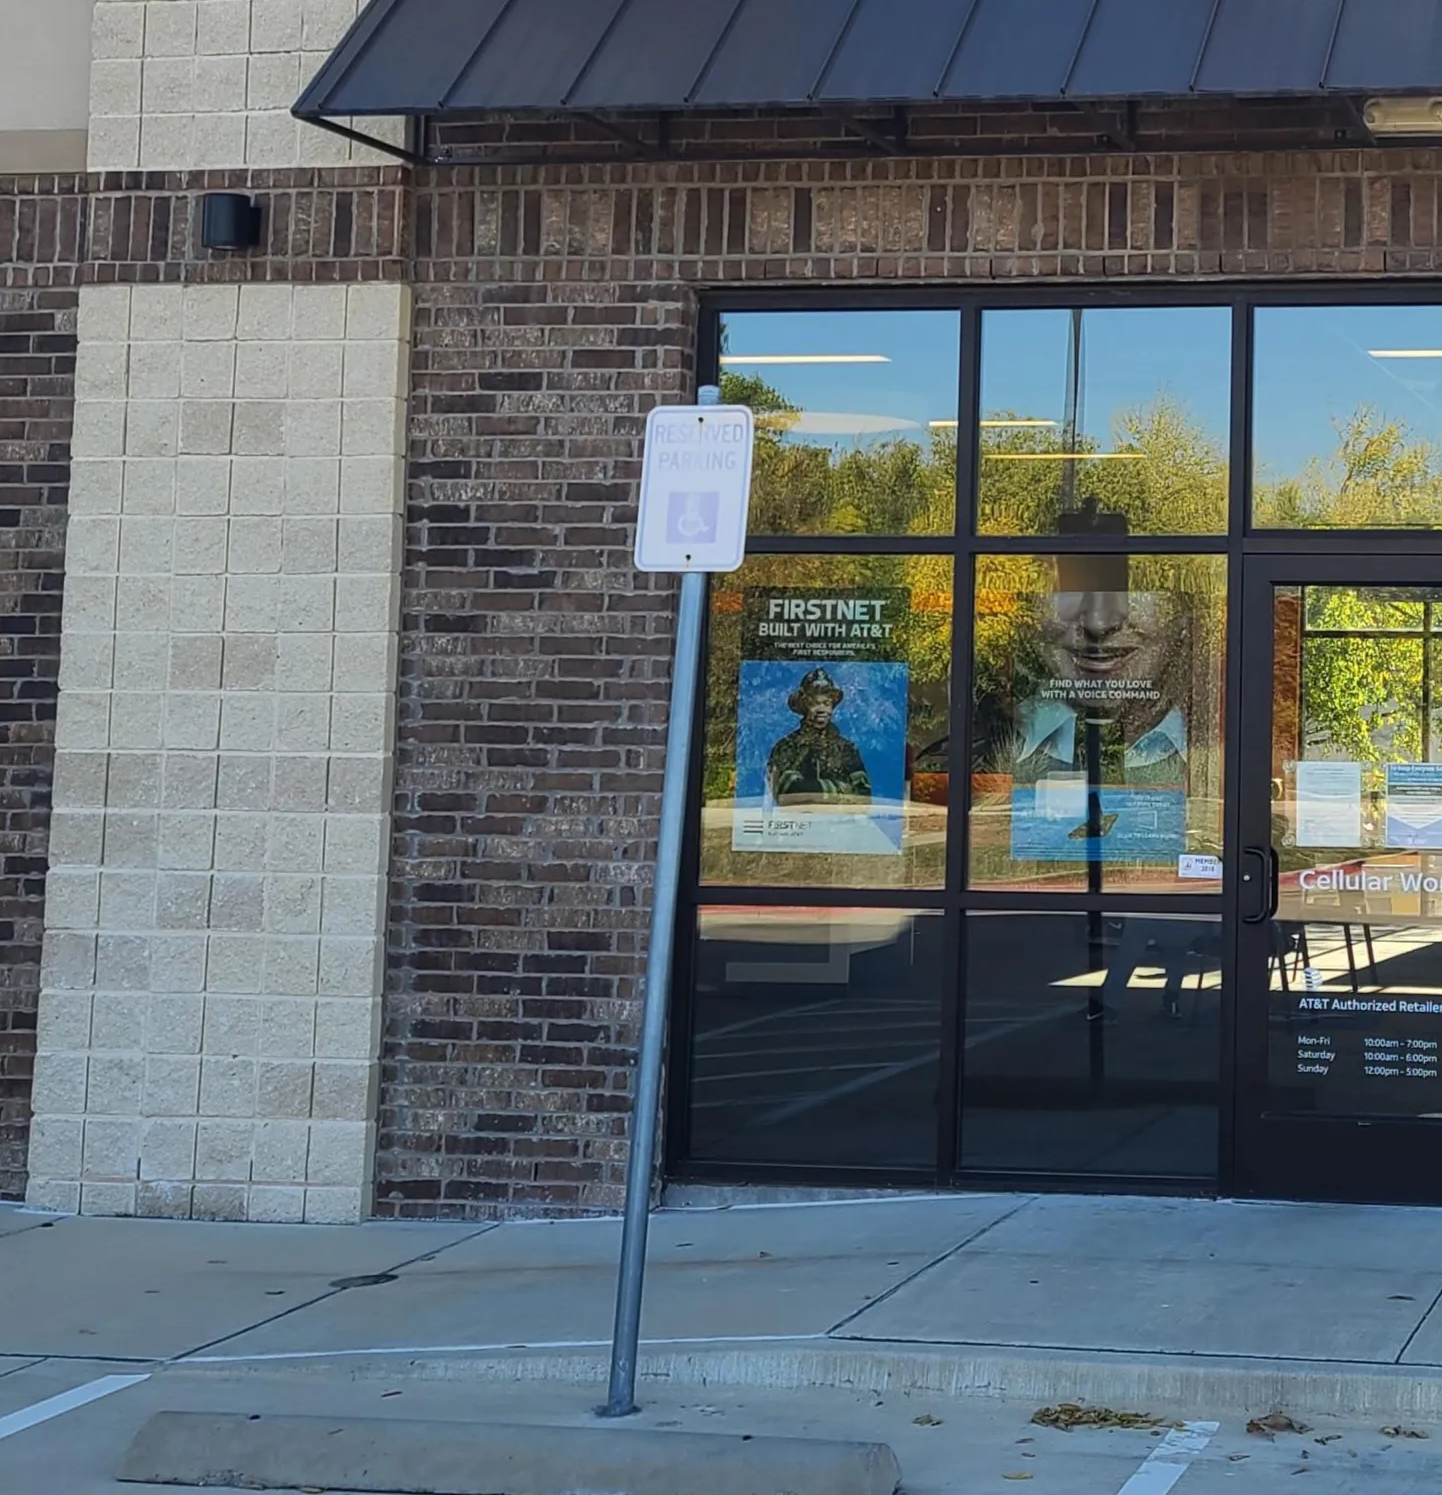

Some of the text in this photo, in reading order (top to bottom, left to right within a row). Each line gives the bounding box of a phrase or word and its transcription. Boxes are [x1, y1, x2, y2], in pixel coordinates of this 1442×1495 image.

[655, 423, 744, 444] RESERVED
[658, 451, 736, 471] PARKING
[768, 599, 886, 620] FIRSTNET
[758, 623, 893, 638] BUILT WITH AT&T
[1050, 679, 1153, 688] FIND WHAT YOU LOVE
[1041, 690, 1160, 699] WITH A VOICE COMMAND
[1299, 870, 1393, 891] Cellular
[1299, 998, 1329, 1010] AT&T
[1332, 998, 1397, 1012] Authorized
[1298, 1036, 1330, 1045] Mon-Fri
[1364, 1038, 1399, 1048] 10:00am
[1407, 1039, 1437, 1050] 7:00pm
[1297, 1050, 1335, 1061] Saturday
[1364, 1052, 1399, 1061] 10:00am
[1406, 1053, 1437, 1063] 6:00pm
[1297, 1064, 1329, 1075] Sunday
[1364, 1066, 1399, 1077] 12:00pm
[1406, 1067, 1437, 1078] 5:00pm
